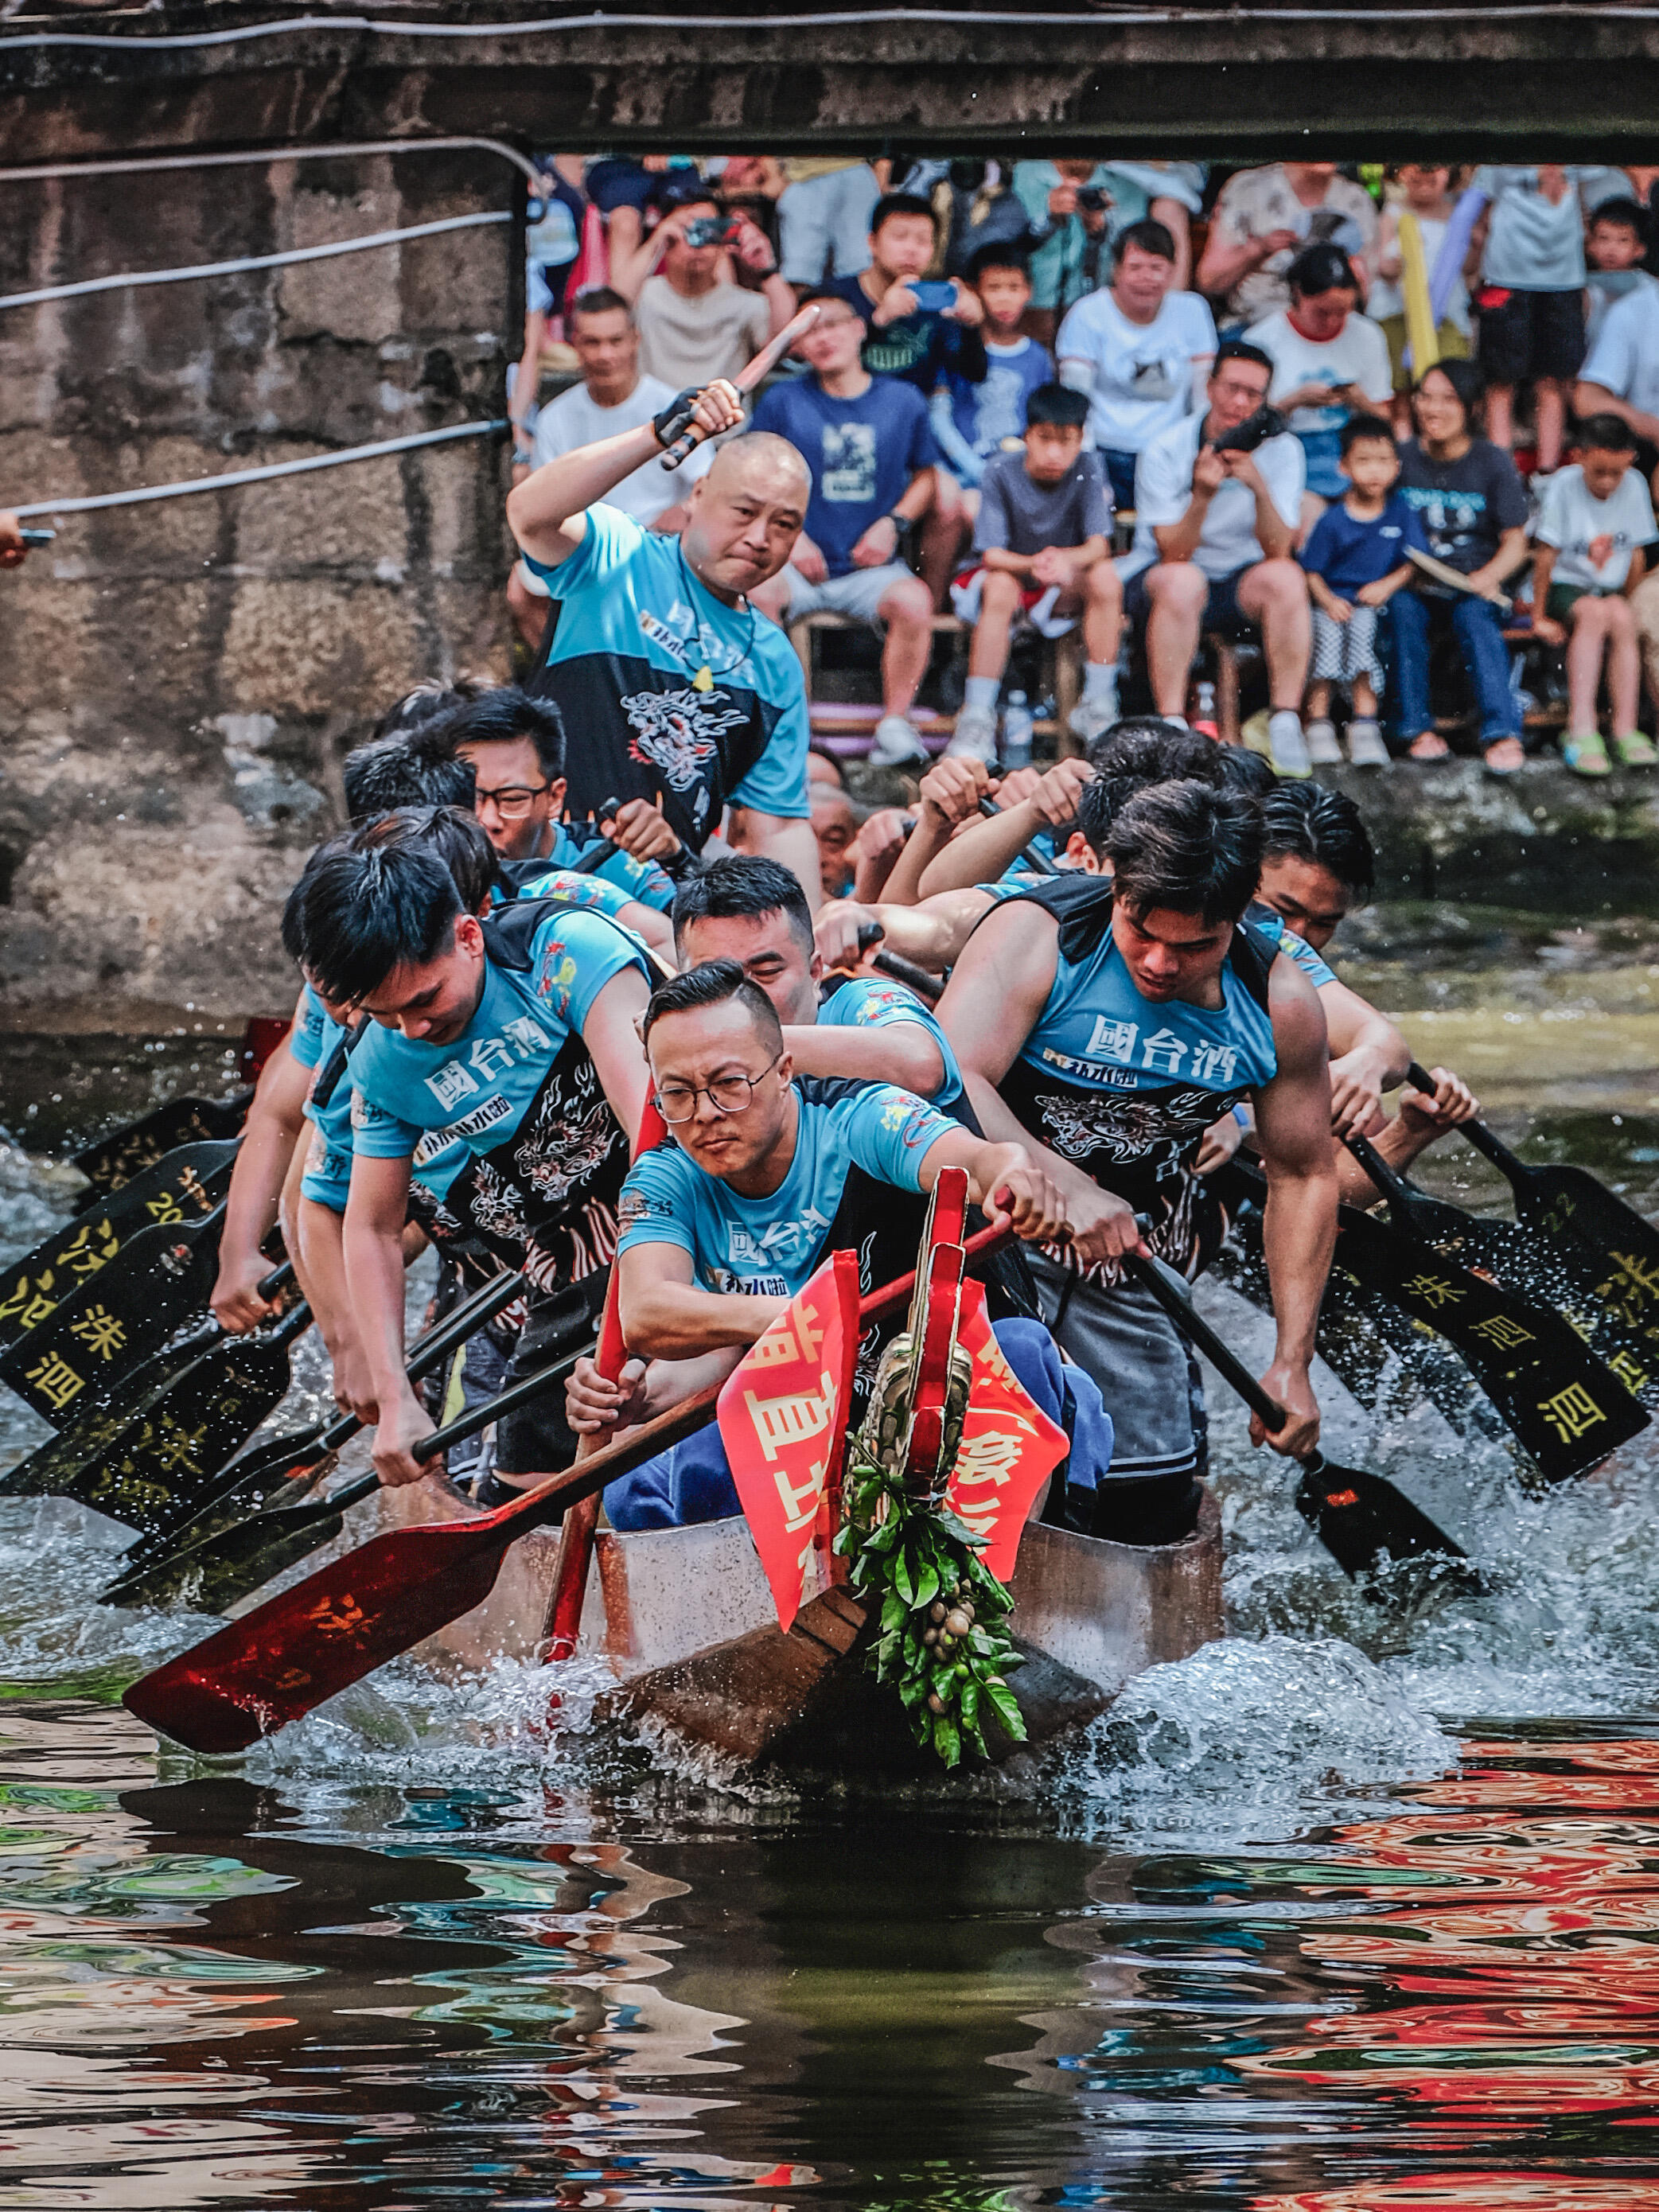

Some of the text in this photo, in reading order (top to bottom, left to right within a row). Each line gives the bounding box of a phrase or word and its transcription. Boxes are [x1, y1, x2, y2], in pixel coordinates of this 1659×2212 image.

[423, 1015, 551, 1112] 國台酒
[1085, 1014, 1237, 1082] 國台酒
[25, 1303, 127, 1408] 洙泗
[1401, 1275, 1536, 1350] 洙泗
